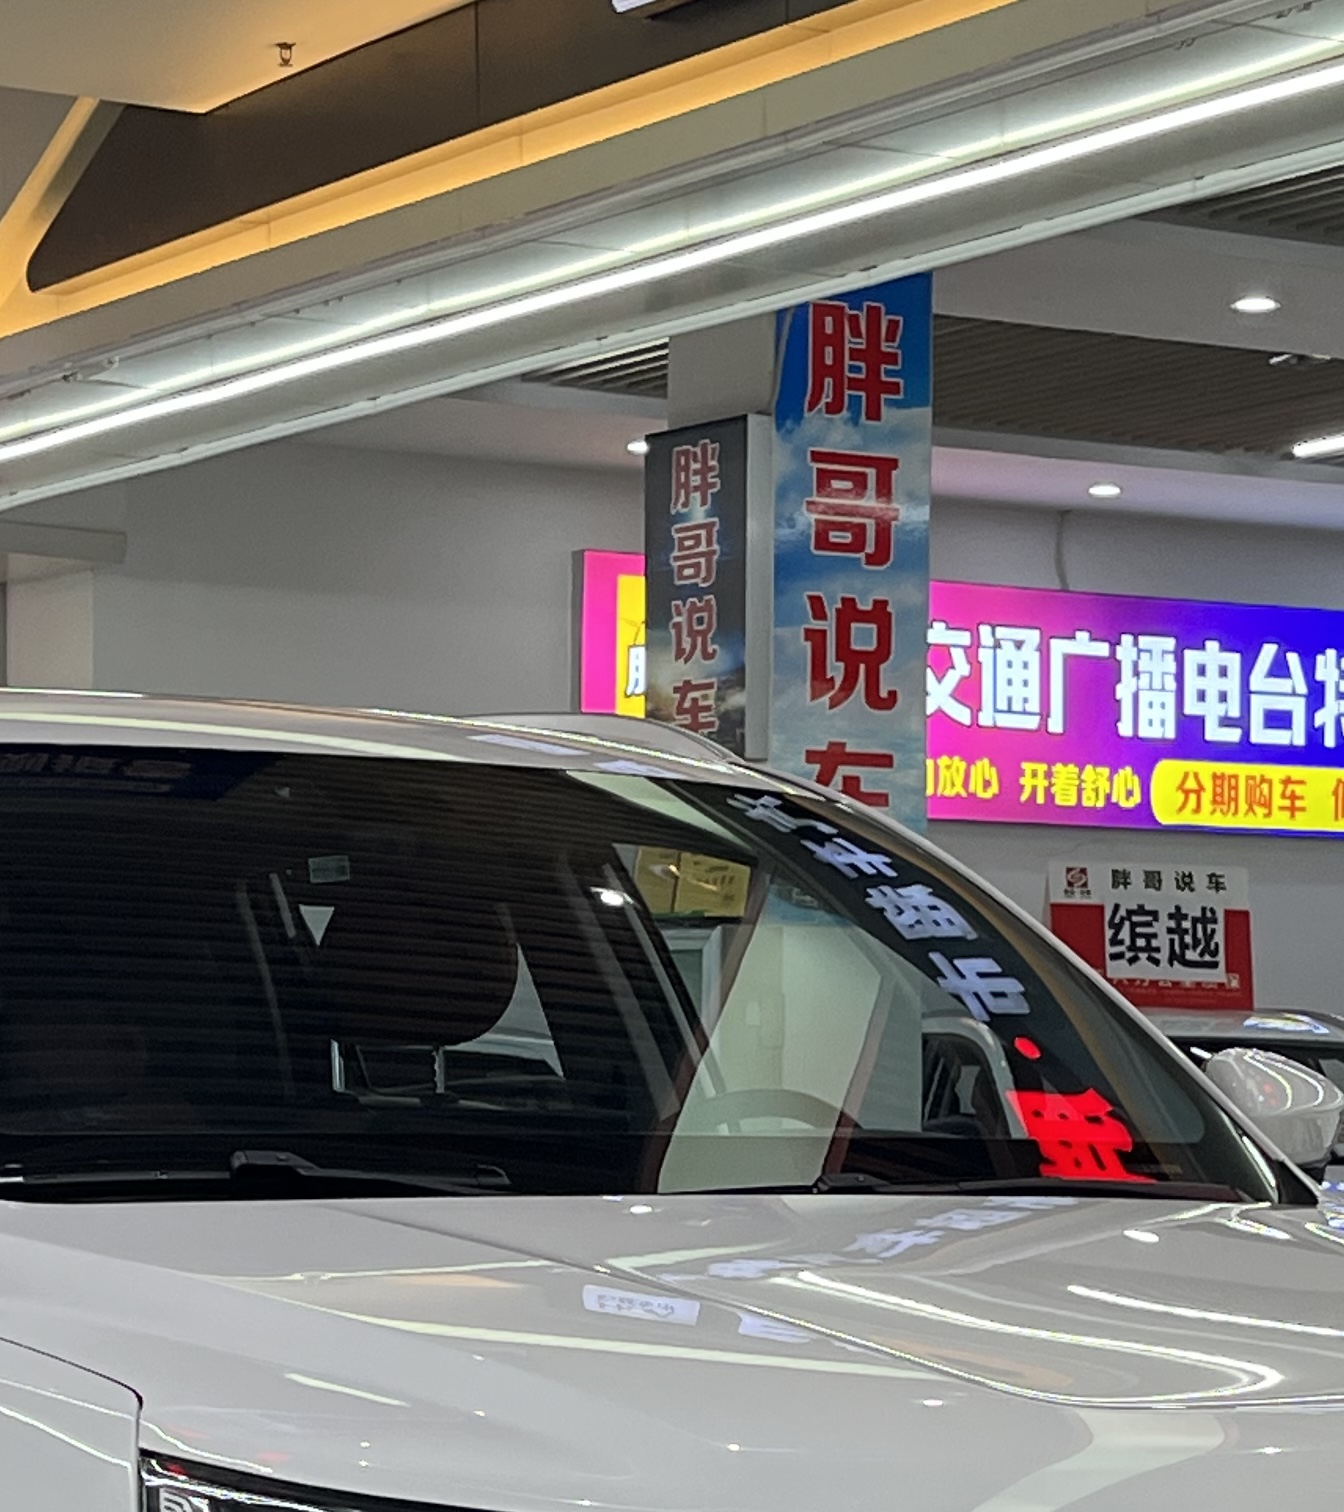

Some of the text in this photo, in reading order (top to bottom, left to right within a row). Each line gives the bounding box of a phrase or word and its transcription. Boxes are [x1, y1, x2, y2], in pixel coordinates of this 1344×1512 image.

[669, 438, 722, 736] 胖哥说车
[926, 755, 1000, 799] 放心
[1019, 760, 1142, 809] 开着舒心
[1175, 770, 1308, 820] 分期购车
[1111, 868, 1227, 893] 胖哥说车
[1108, 903, 1220, 970] 缤越
